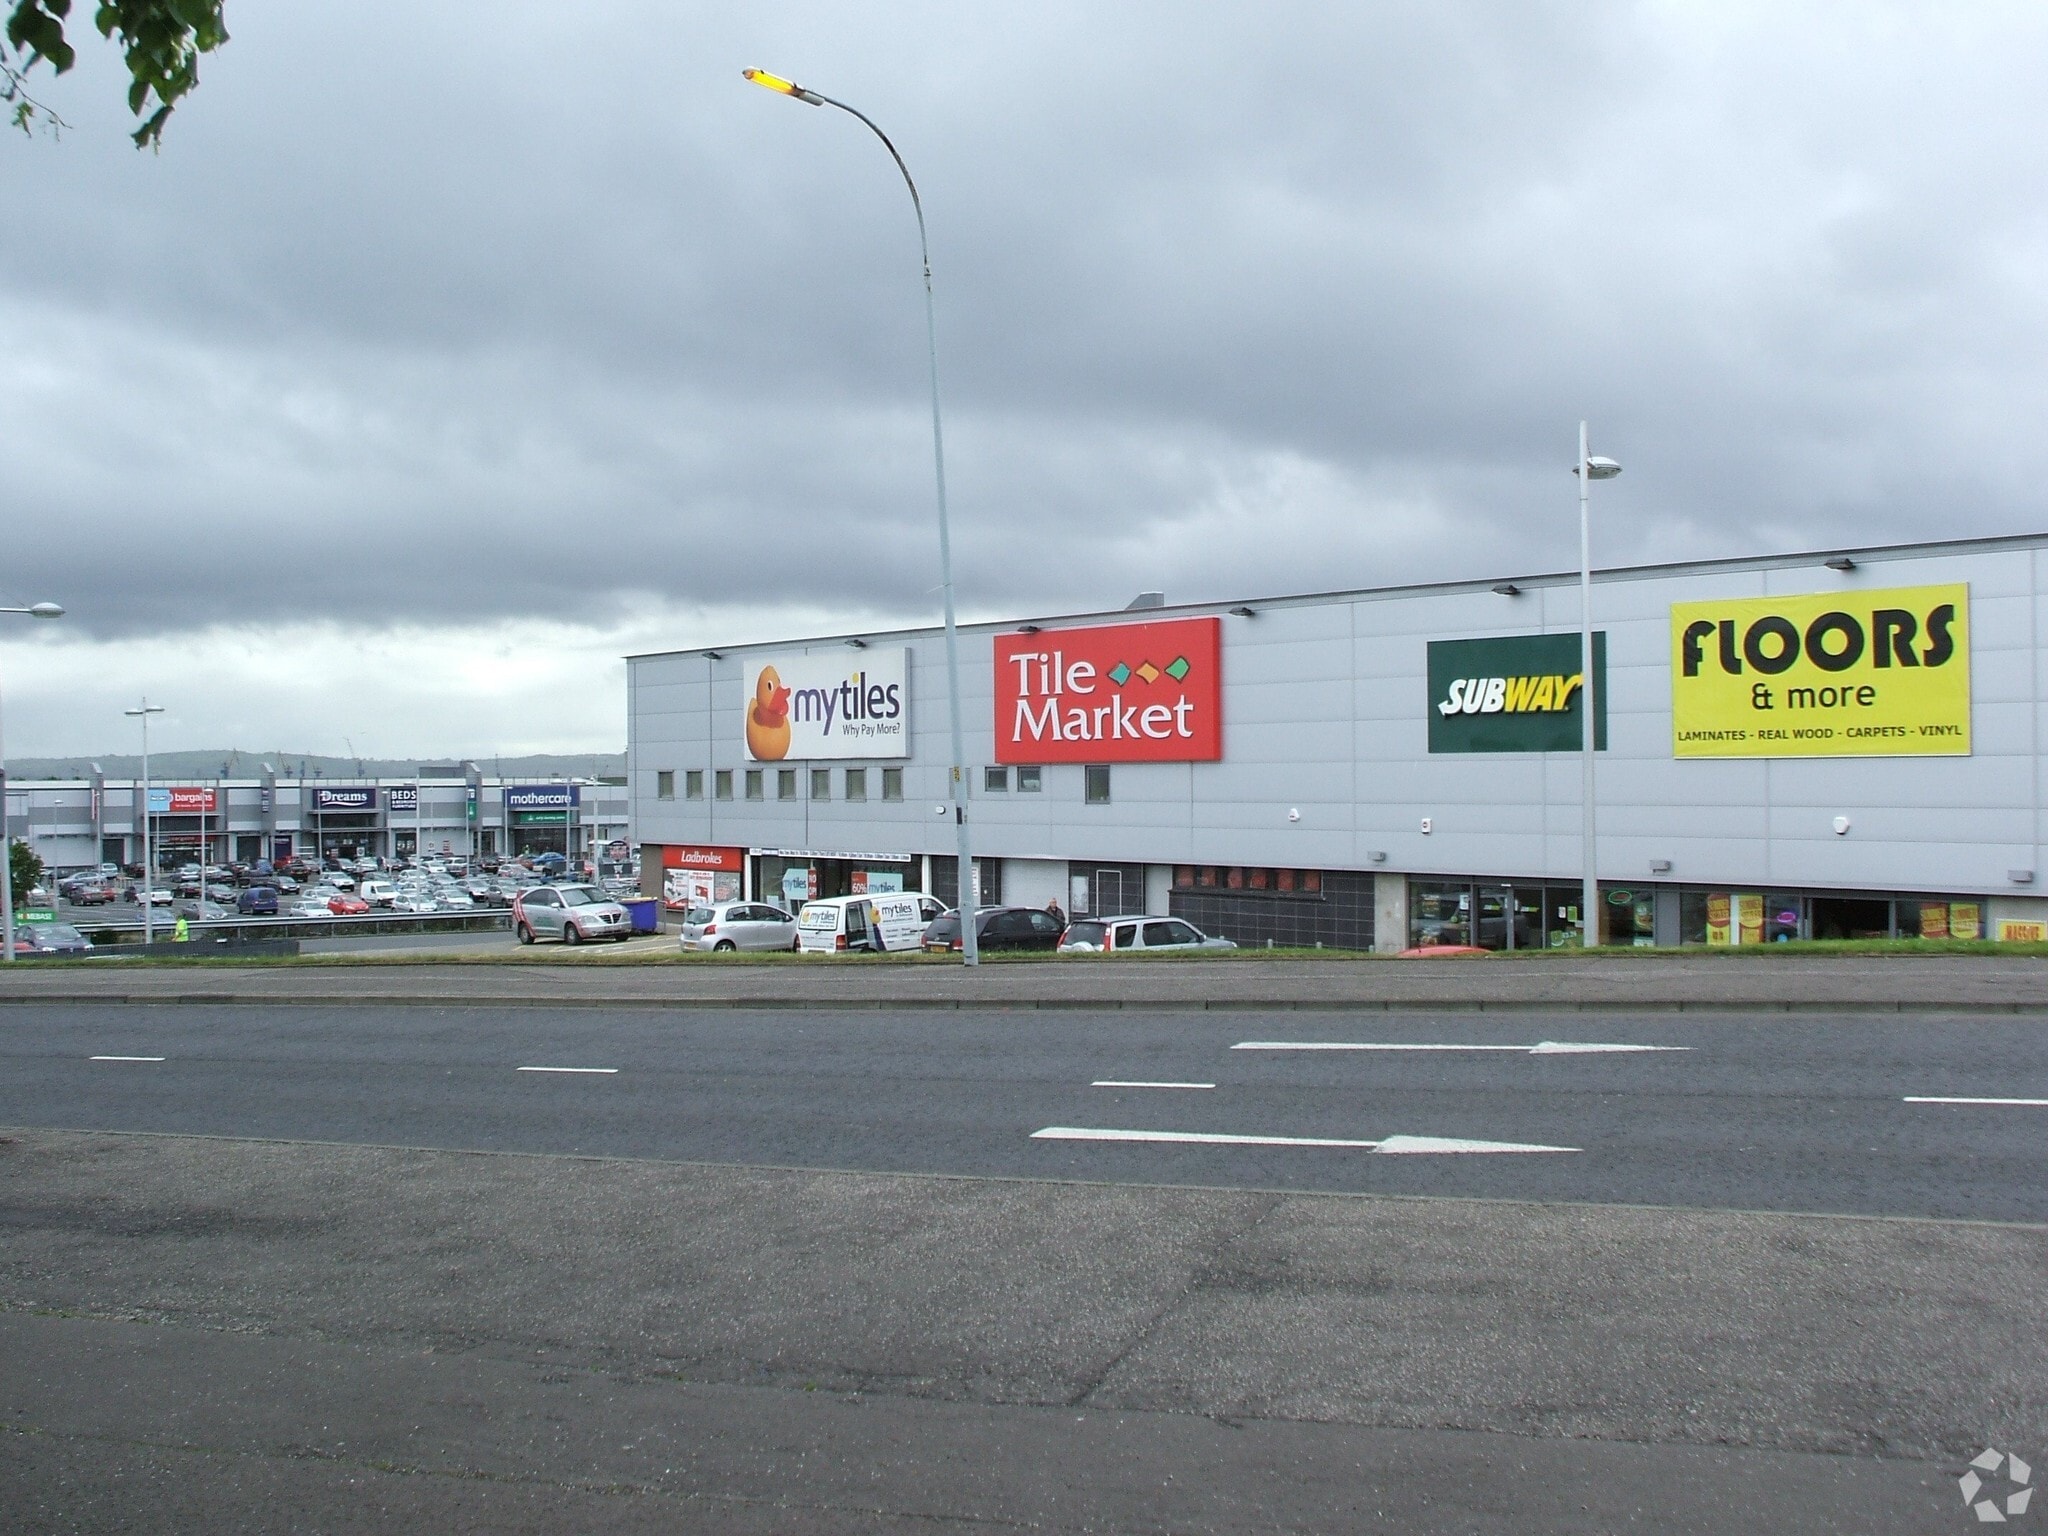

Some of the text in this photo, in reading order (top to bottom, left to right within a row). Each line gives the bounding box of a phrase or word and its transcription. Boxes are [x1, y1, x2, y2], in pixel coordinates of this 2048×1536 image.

[1682, 603, 1954, 677] FLOORS
[1009, 651, 1096, 696] Tile
[1438, 672, 1584, 716] SUBWAY
[1752, 682, 1876, 711] & more
[794, 671, 900, 736] mytiles
[1012, 694, 1194, 742] Market
[842, 722, 901, 738] Why Pay More?
[1677, 730, 1746, 742] LAMINATES
[1758, 729, 1789, 740] REAL
[1793, 728, 1833, 739] WOOD
[1846, 726, 1906, 738] CARPETS
[1919, 725, 1962, 737] VINYL
[174, 793, 213, 804] bargains
[321, 790, 368, 802] Dreams
[391, 790, 417, 800] BEDS
[510, 792, 572, 805] mothercare
[681, 850, 723, 864] Ladbrokes
[783, 876, 807, 891] mytiles
[852, 882, 868, 894] 60%
[869, 881, 896, 894] mytiles
[811, 911, 836, 923] mytiles
[882, 902, 912, 918] mytiles
